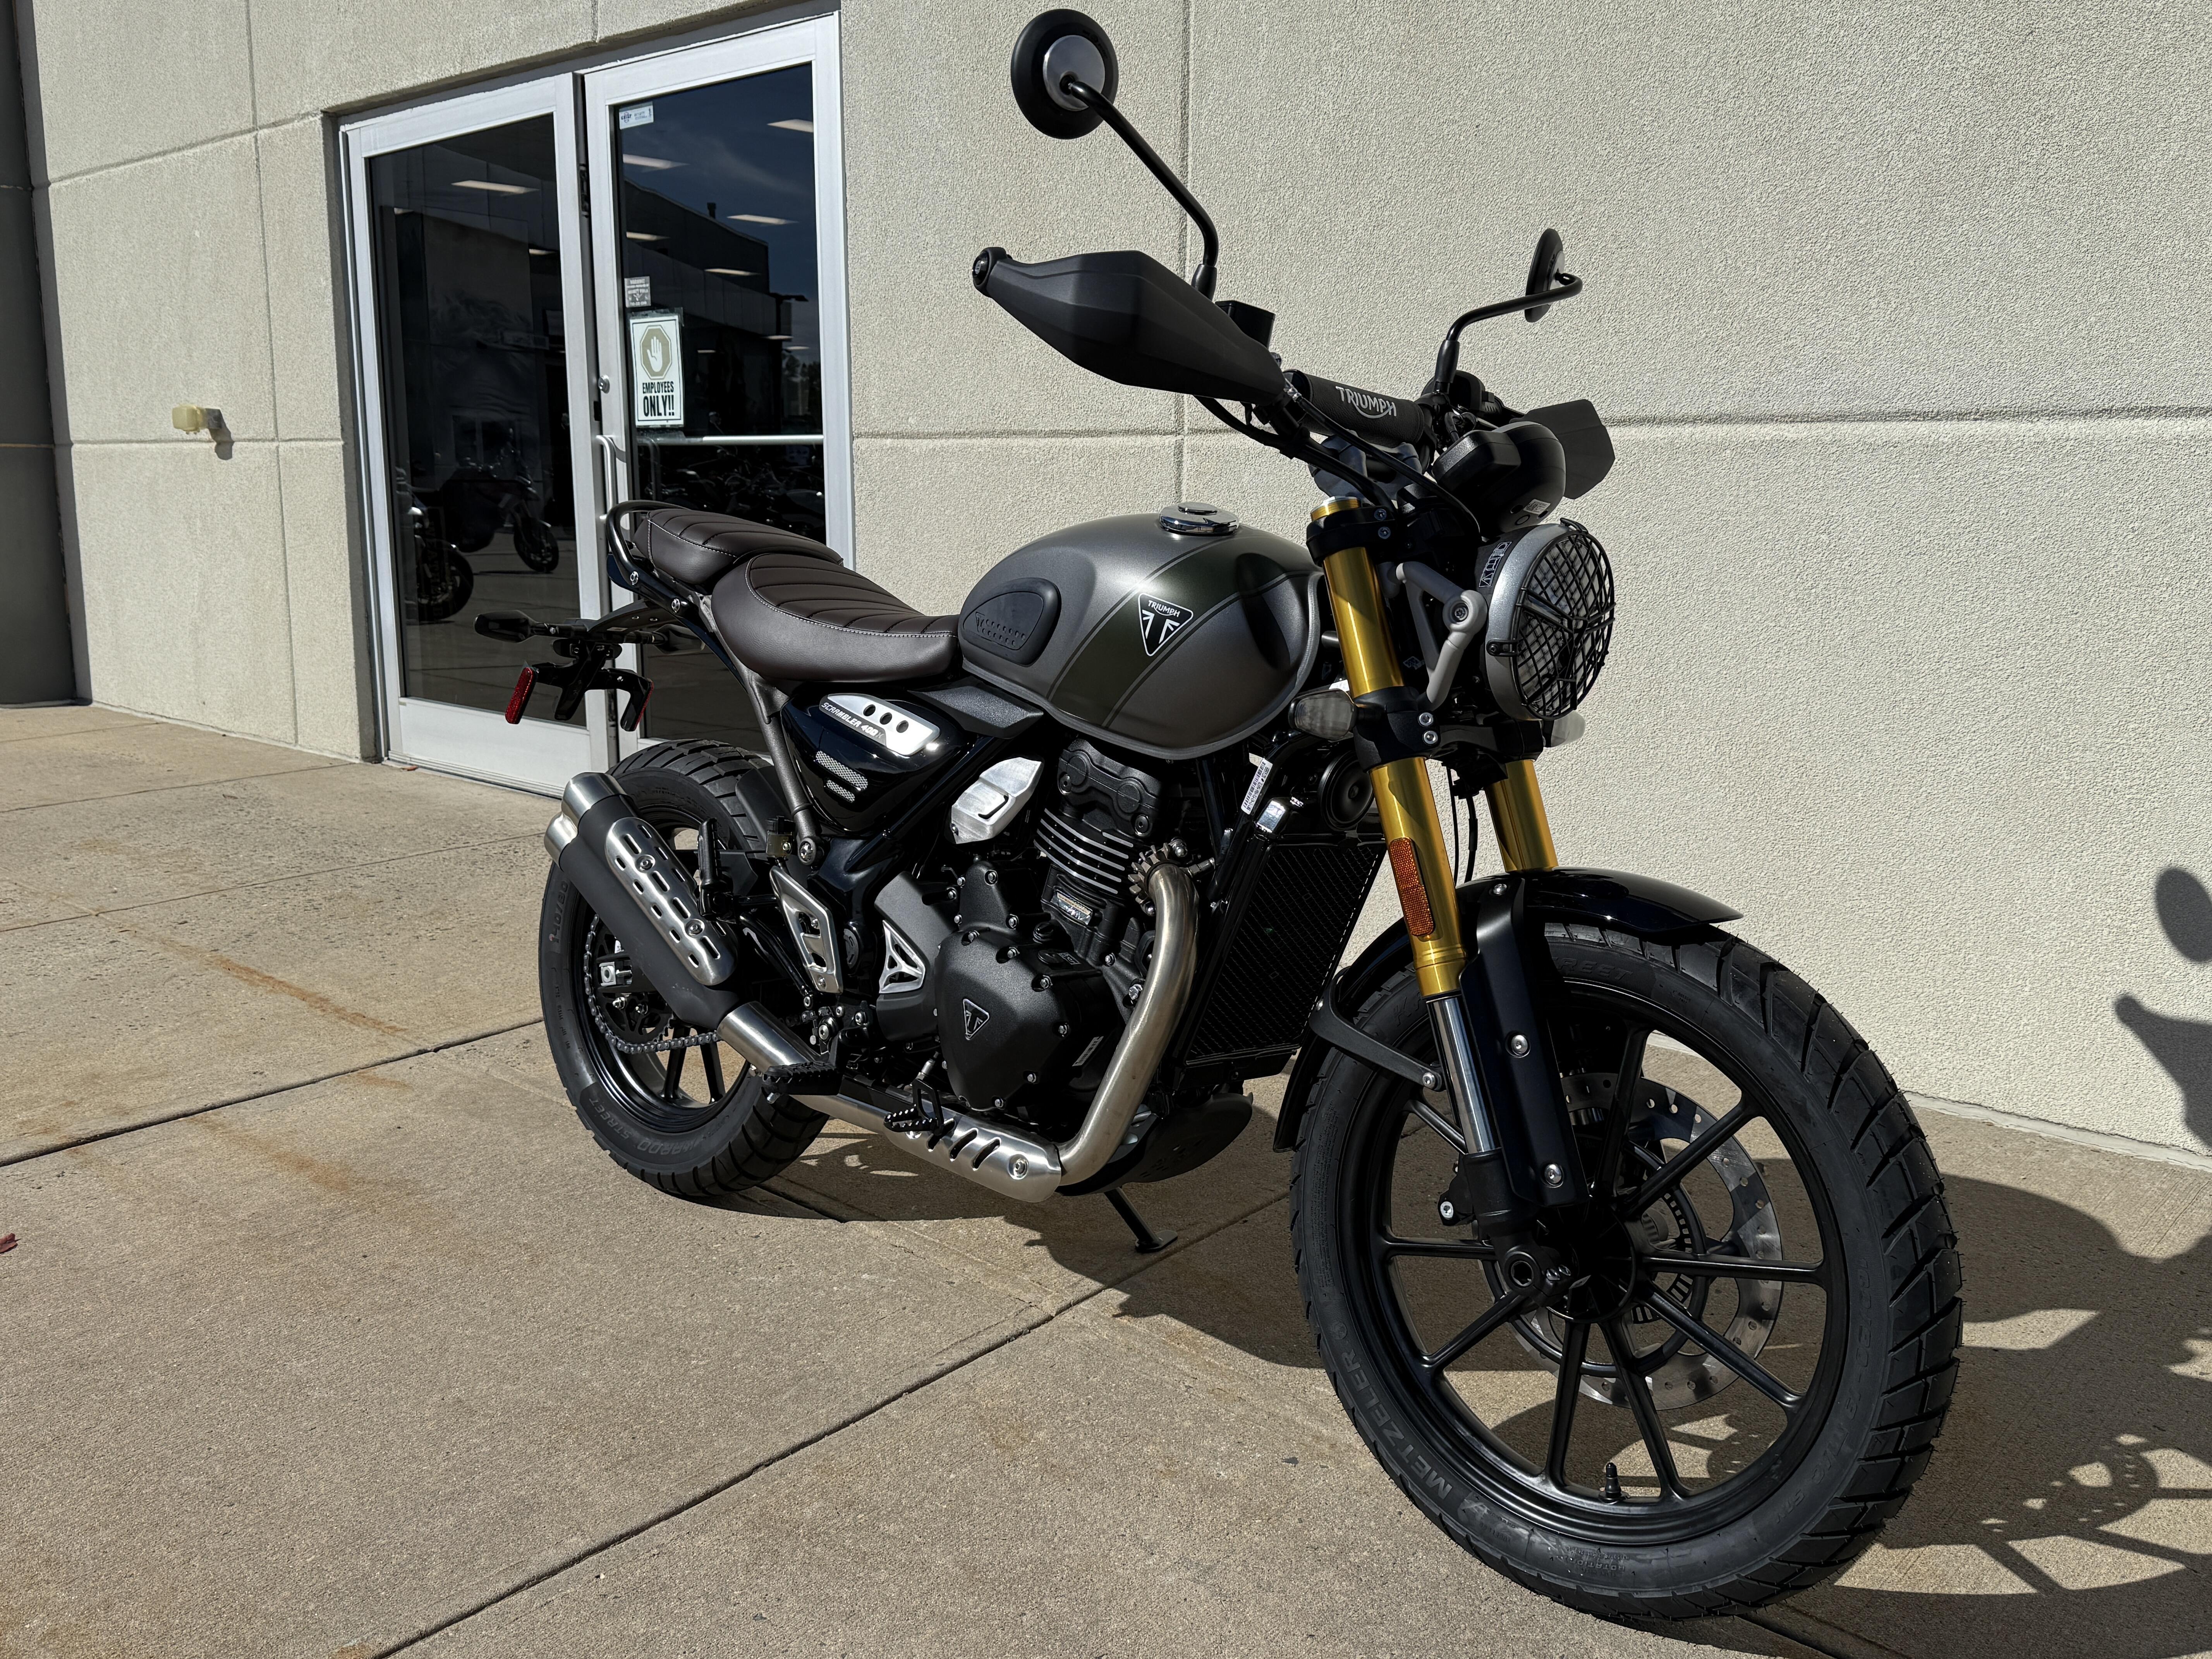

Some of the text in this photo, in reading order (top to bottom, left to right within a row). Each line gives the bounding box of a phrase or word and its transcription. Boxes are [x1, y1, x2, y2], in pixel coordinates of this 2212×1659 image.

[642, 381, 674, 394] EMPLOYEES
[643, 394, 674, 417] ONLY!!
[1335, 386, 1397, 419] TRIUMPH
[1148, 600, 1180, 617] TRIUMPH
[821, 702, 862, 728] SCRAMBLER
[589, 1098, 632, 1139] STREET
[1341, 1349, 1453, 1499] METZELER
